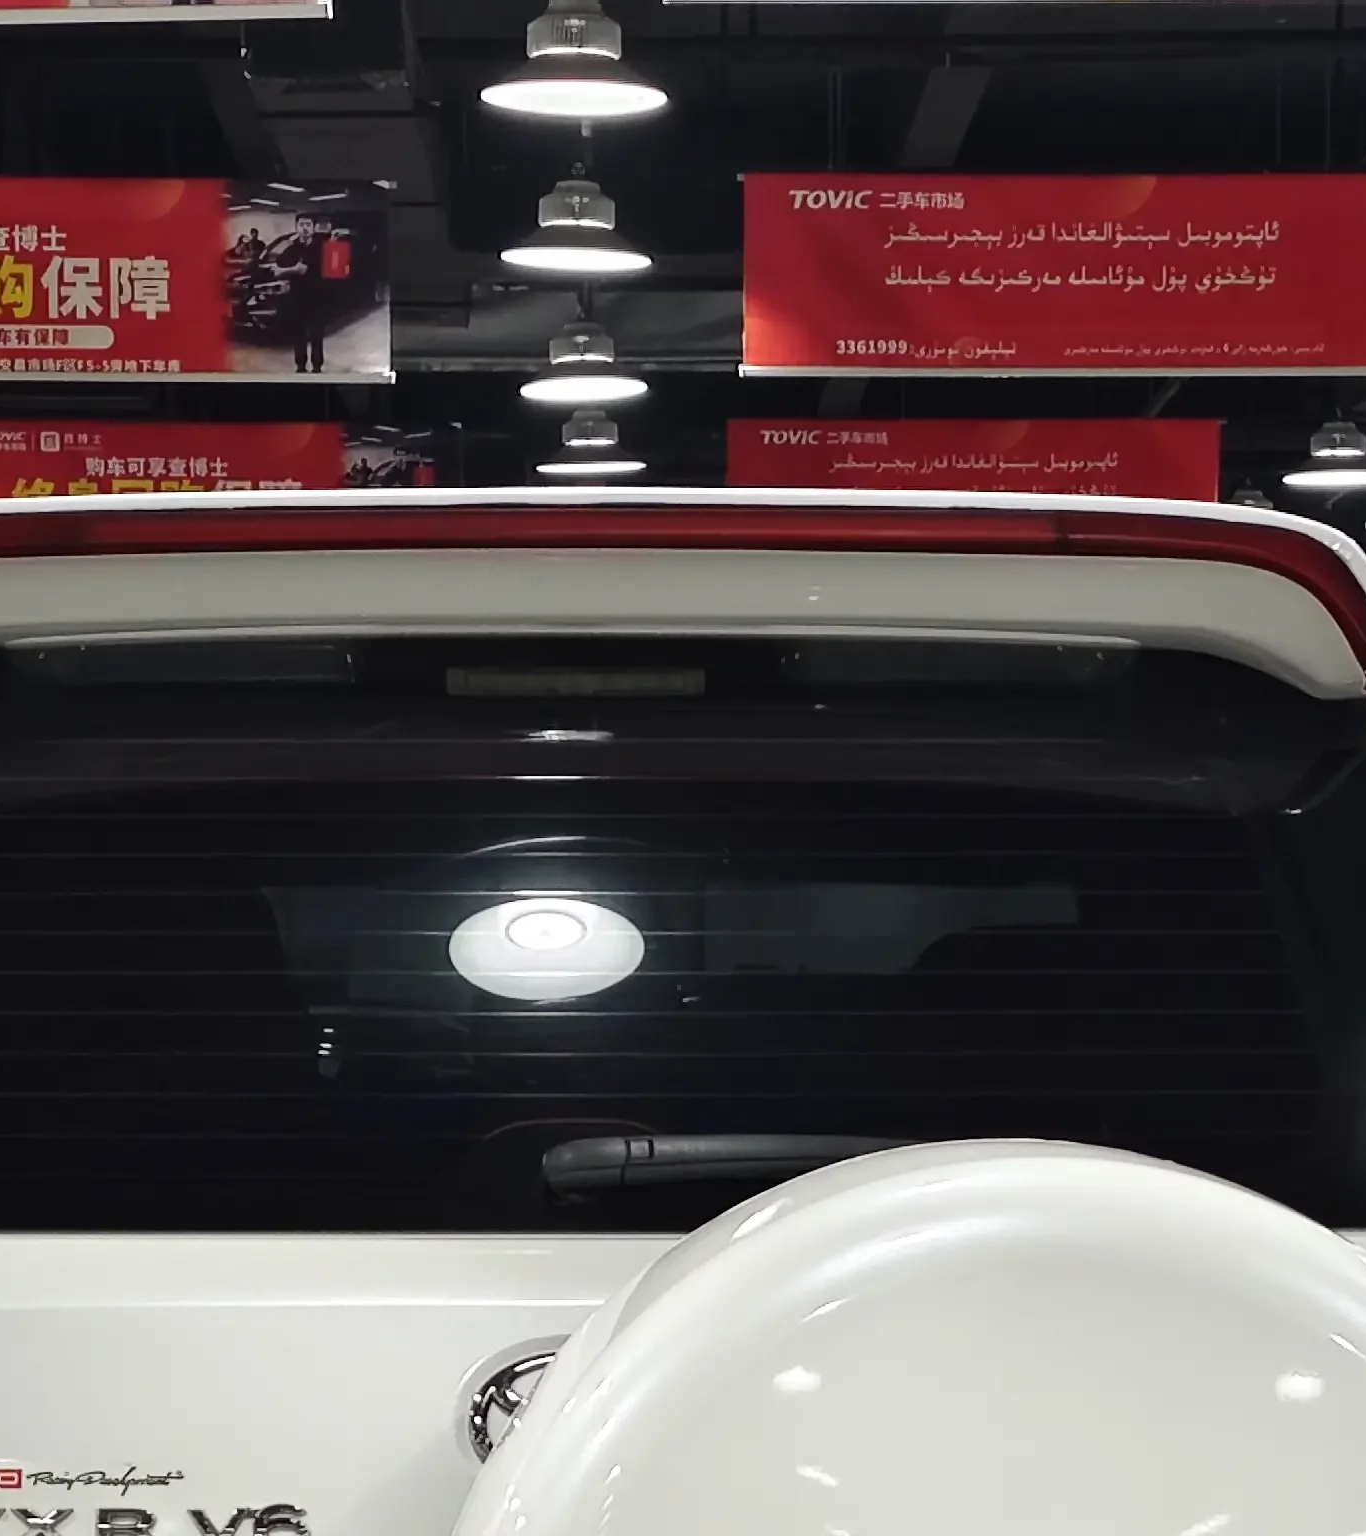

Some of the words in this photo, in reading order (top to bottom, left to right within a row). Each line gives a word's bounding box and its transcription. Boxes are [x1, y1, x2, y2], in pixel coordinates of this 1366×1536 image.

[790, 190, 873, 209] TOVIC
[879, 192, 966, 210] 二手车市场
[760, 430, 821, 445] TOVIC
[85, 456, 229, 478] 购车可享查博士
